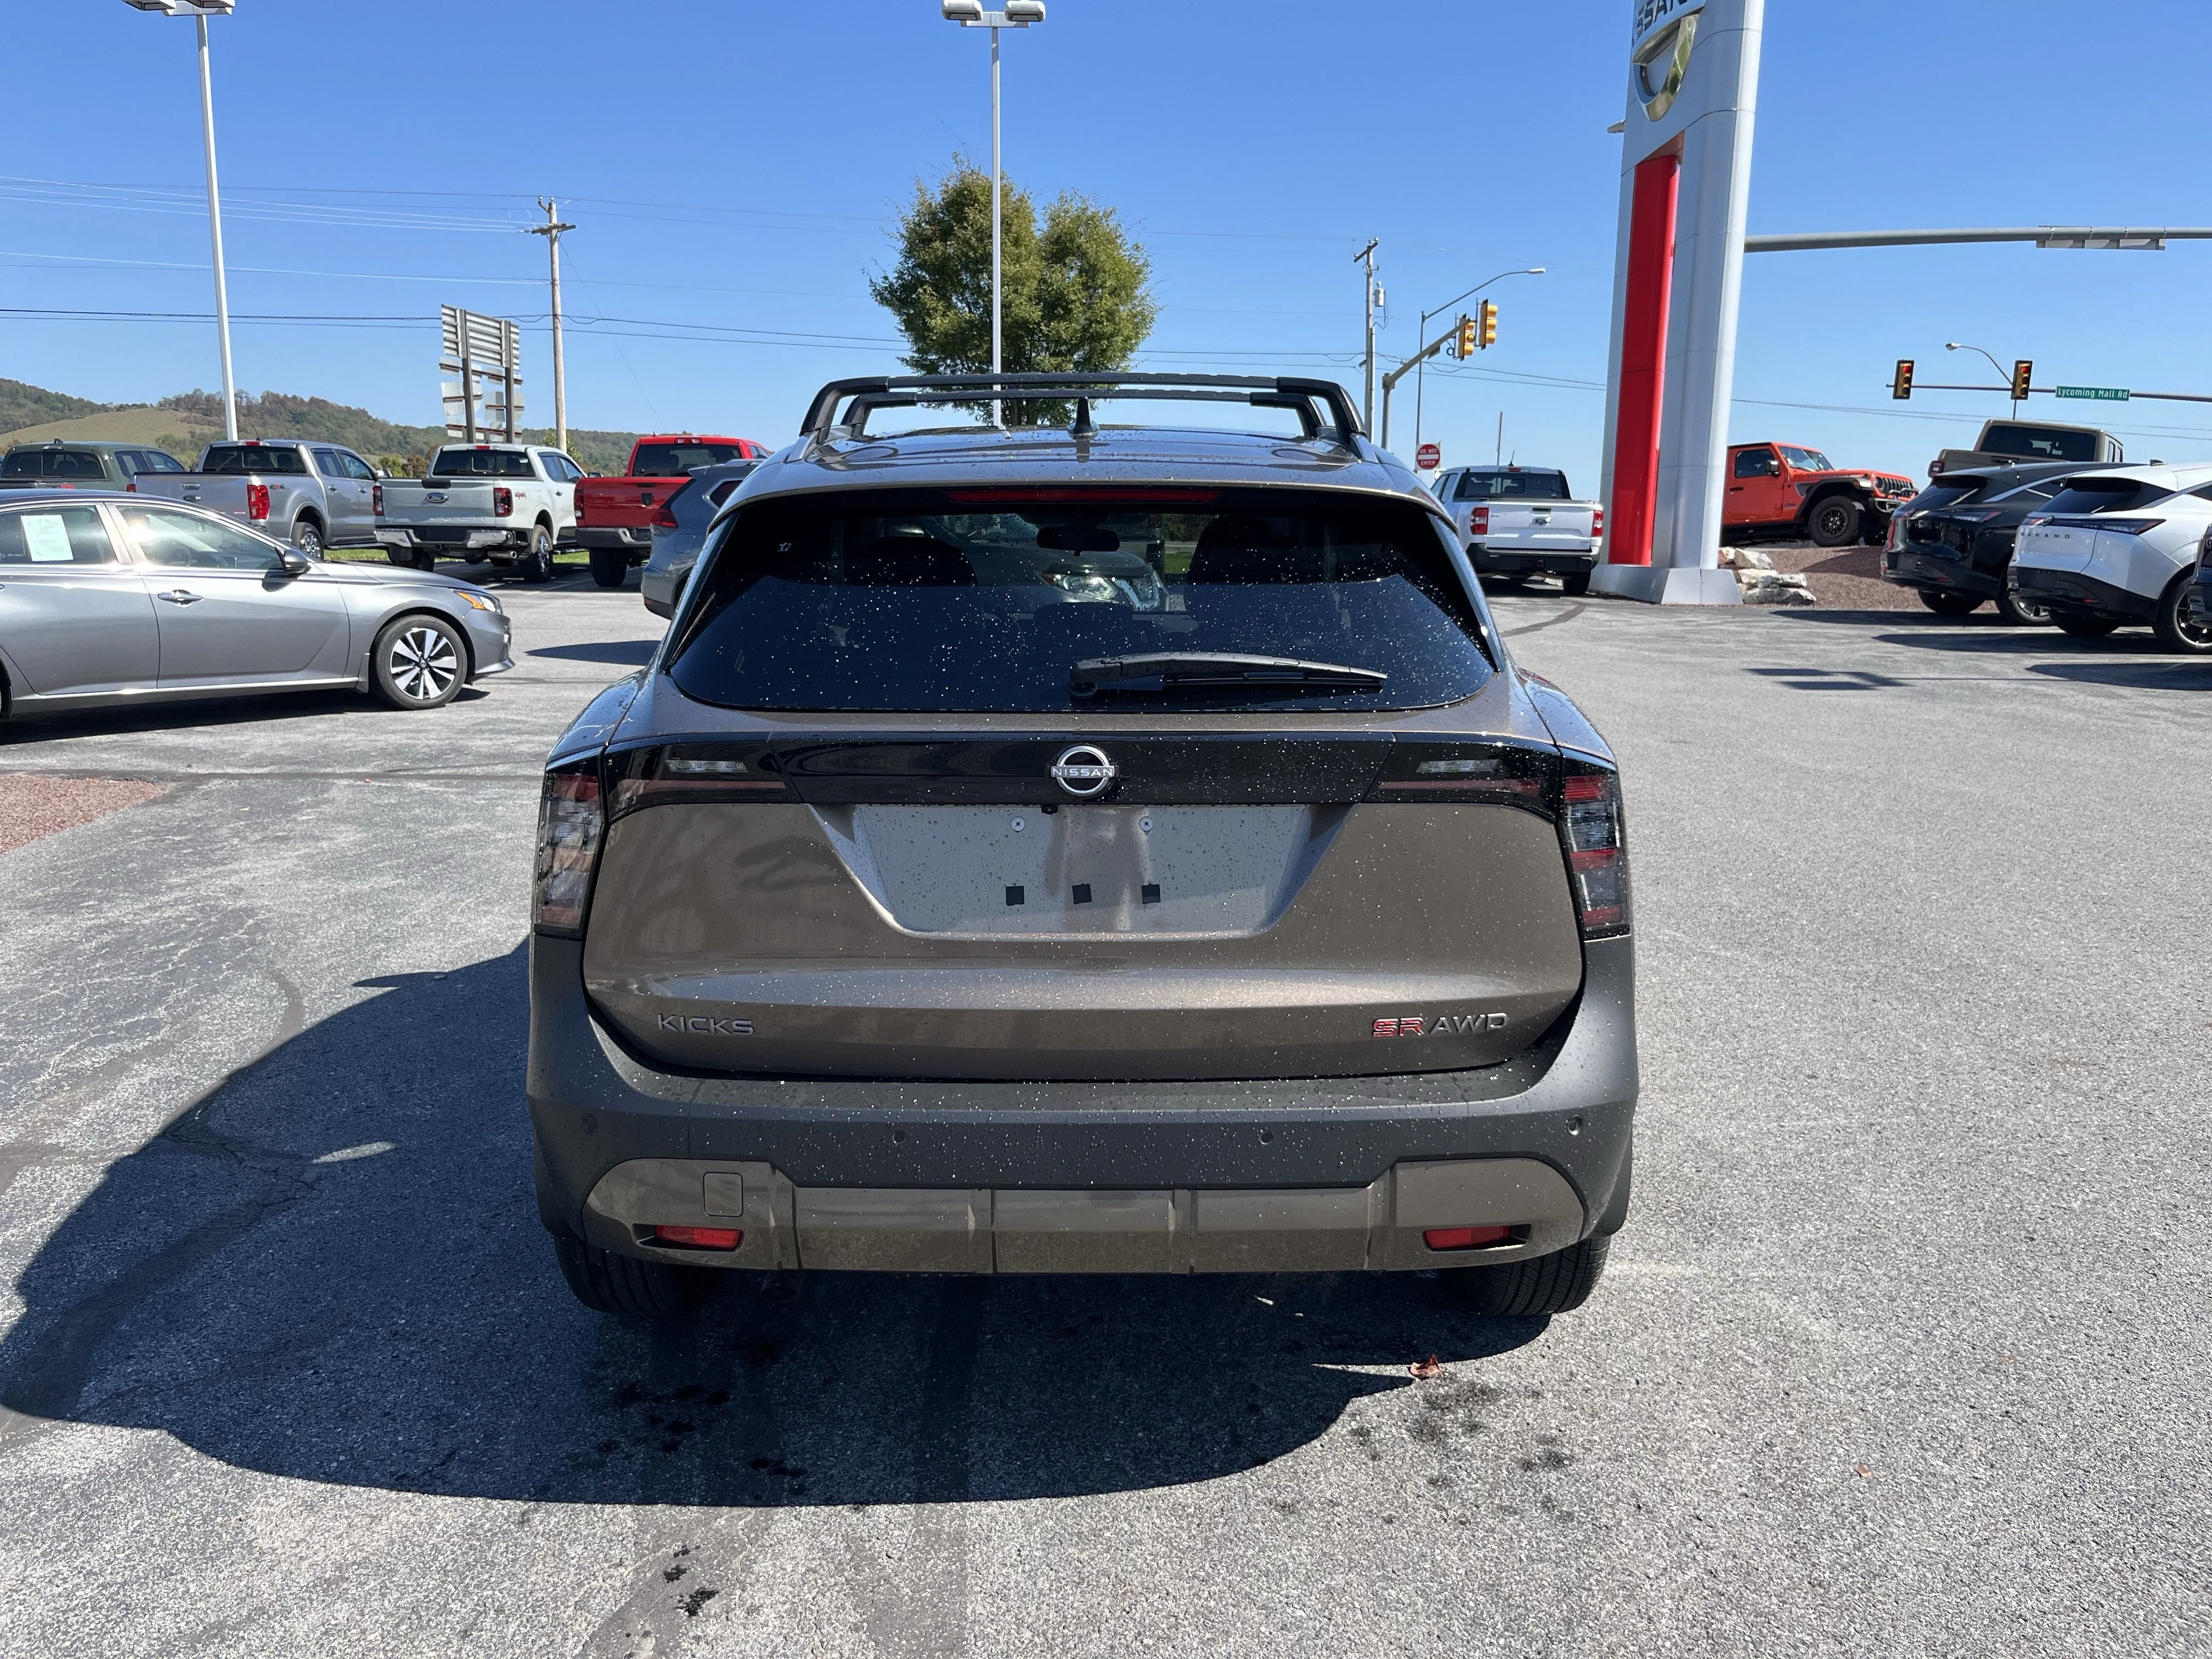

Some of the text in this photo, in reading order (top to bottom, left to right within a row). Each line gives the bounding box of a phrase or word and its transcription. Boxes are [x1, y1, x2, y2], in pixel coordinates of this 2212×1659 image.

[2058, 388, 2128, 398] Lycoming Mall Rd
[1052, 768, 1113, 777] NISSAN
[658, 1013, 755, 1036] KICKS
[1373, 1012, 1508, 1037] SR AWD
